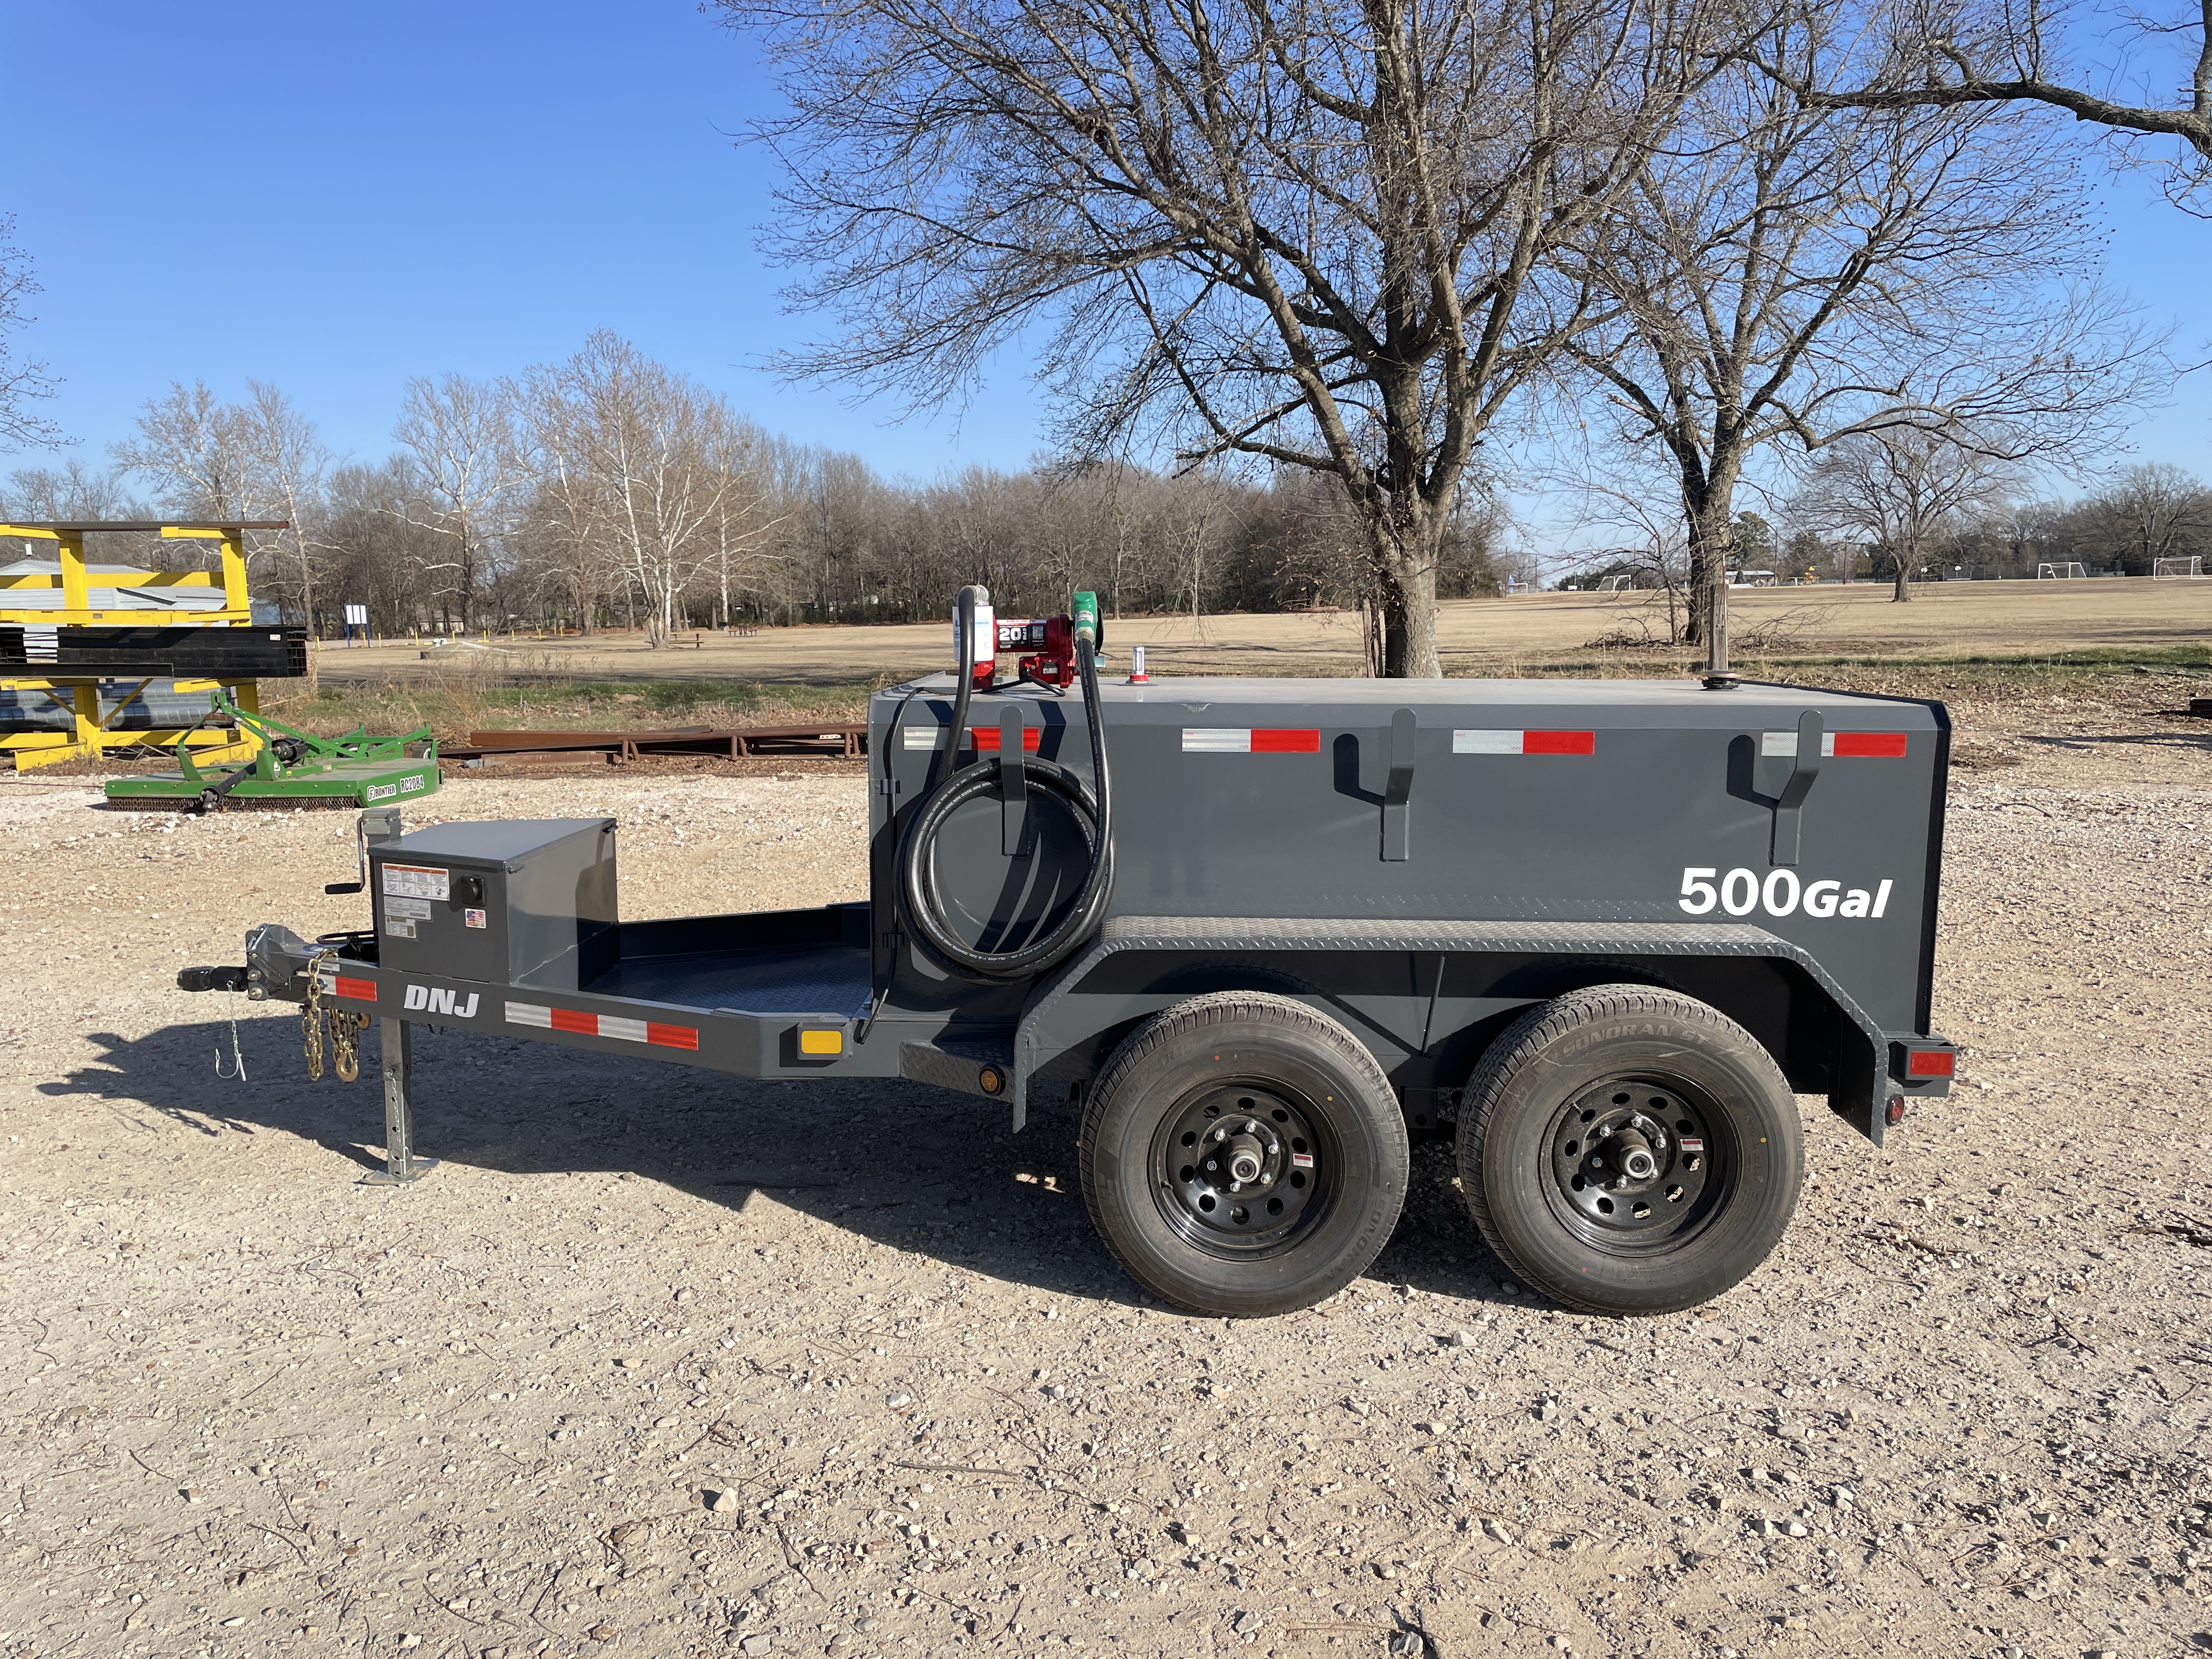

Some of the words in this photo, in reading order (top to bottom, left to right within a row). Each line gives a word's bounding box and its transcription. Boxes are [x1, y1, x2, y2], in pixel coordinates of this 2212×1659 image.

[999, 628, 1022, 641] 20
[368, 785, 396, 800] FRONTIER
[400, 776, 424, 792] RC2084
[1678, 867, 1893, 918] 500Gal
[403, 984, 480, 1019] DNJ
[1562, 1024, 1675, 1058] SONORAN
[1321, 1196, 1387, 1283] SONORAN
